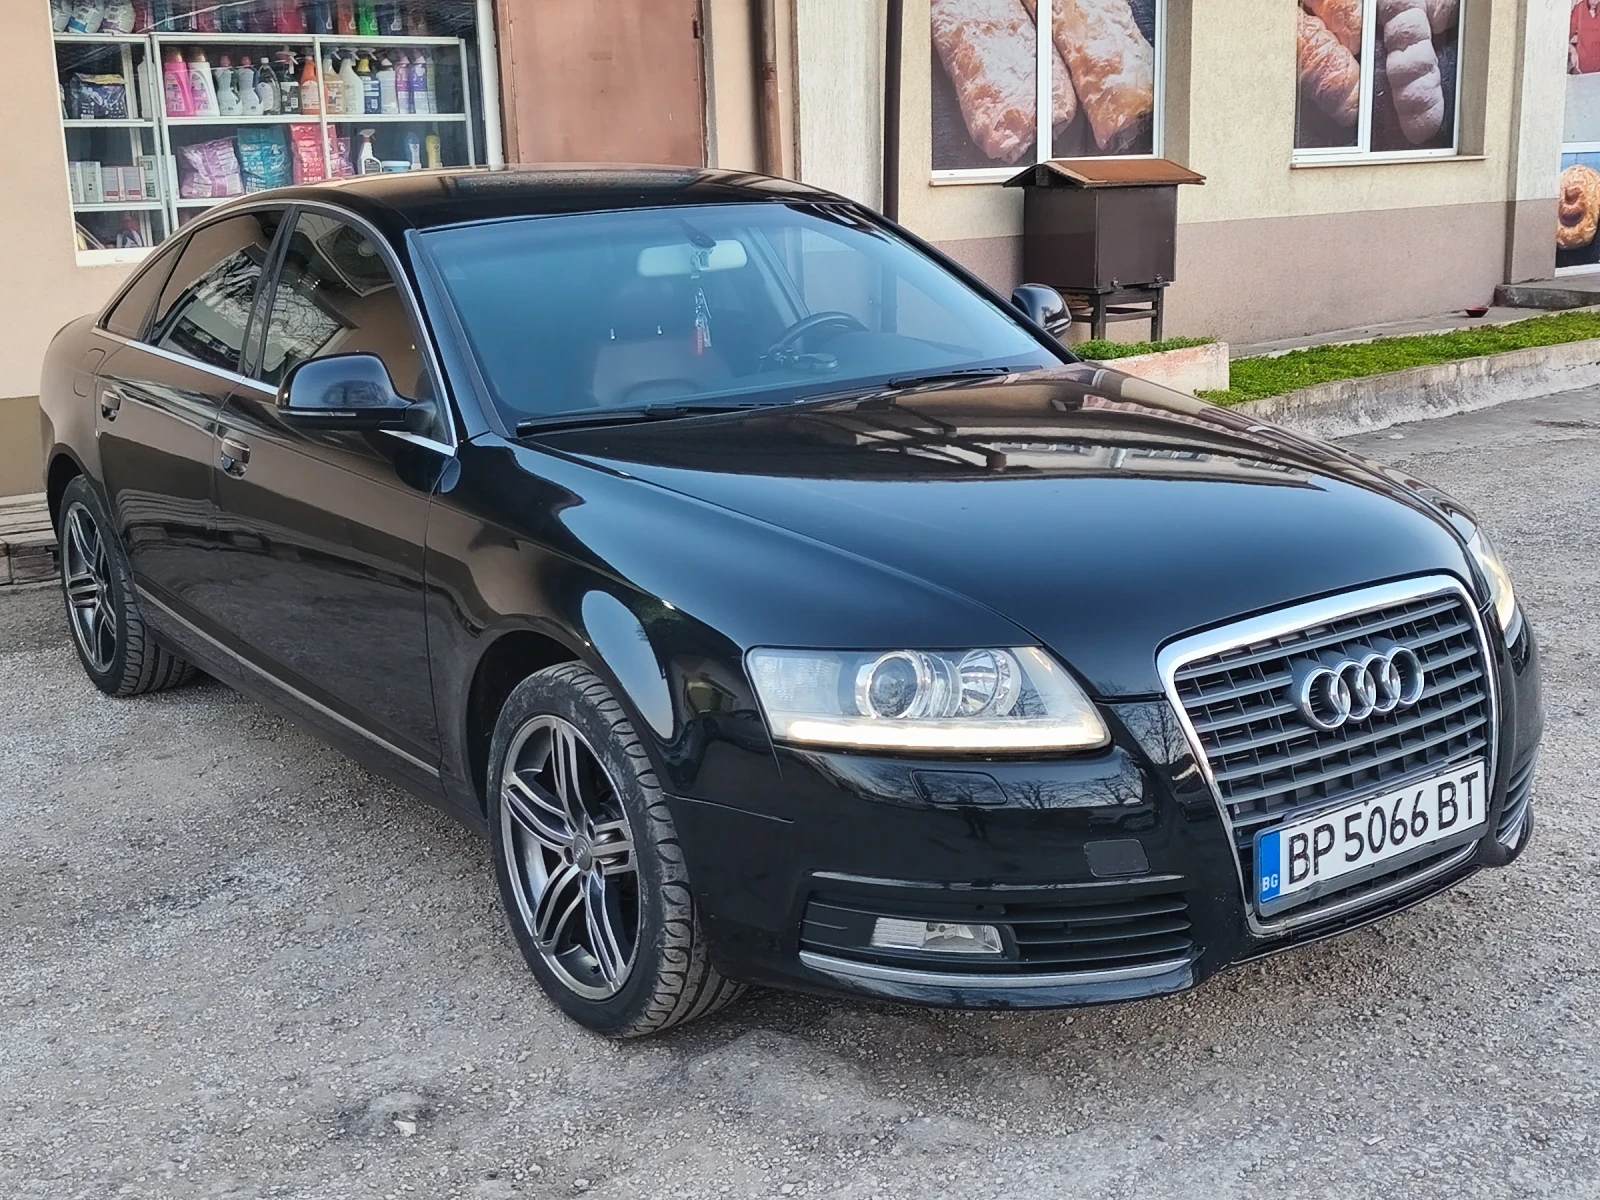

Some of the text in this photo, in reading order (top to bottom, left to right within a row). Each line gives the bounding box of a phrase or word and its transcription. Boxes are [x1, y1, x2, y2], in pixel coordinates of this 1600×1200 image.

[1289, 771, 1478, 884] BP 5066 BT
[1262, 874, 1279, 892] BG
